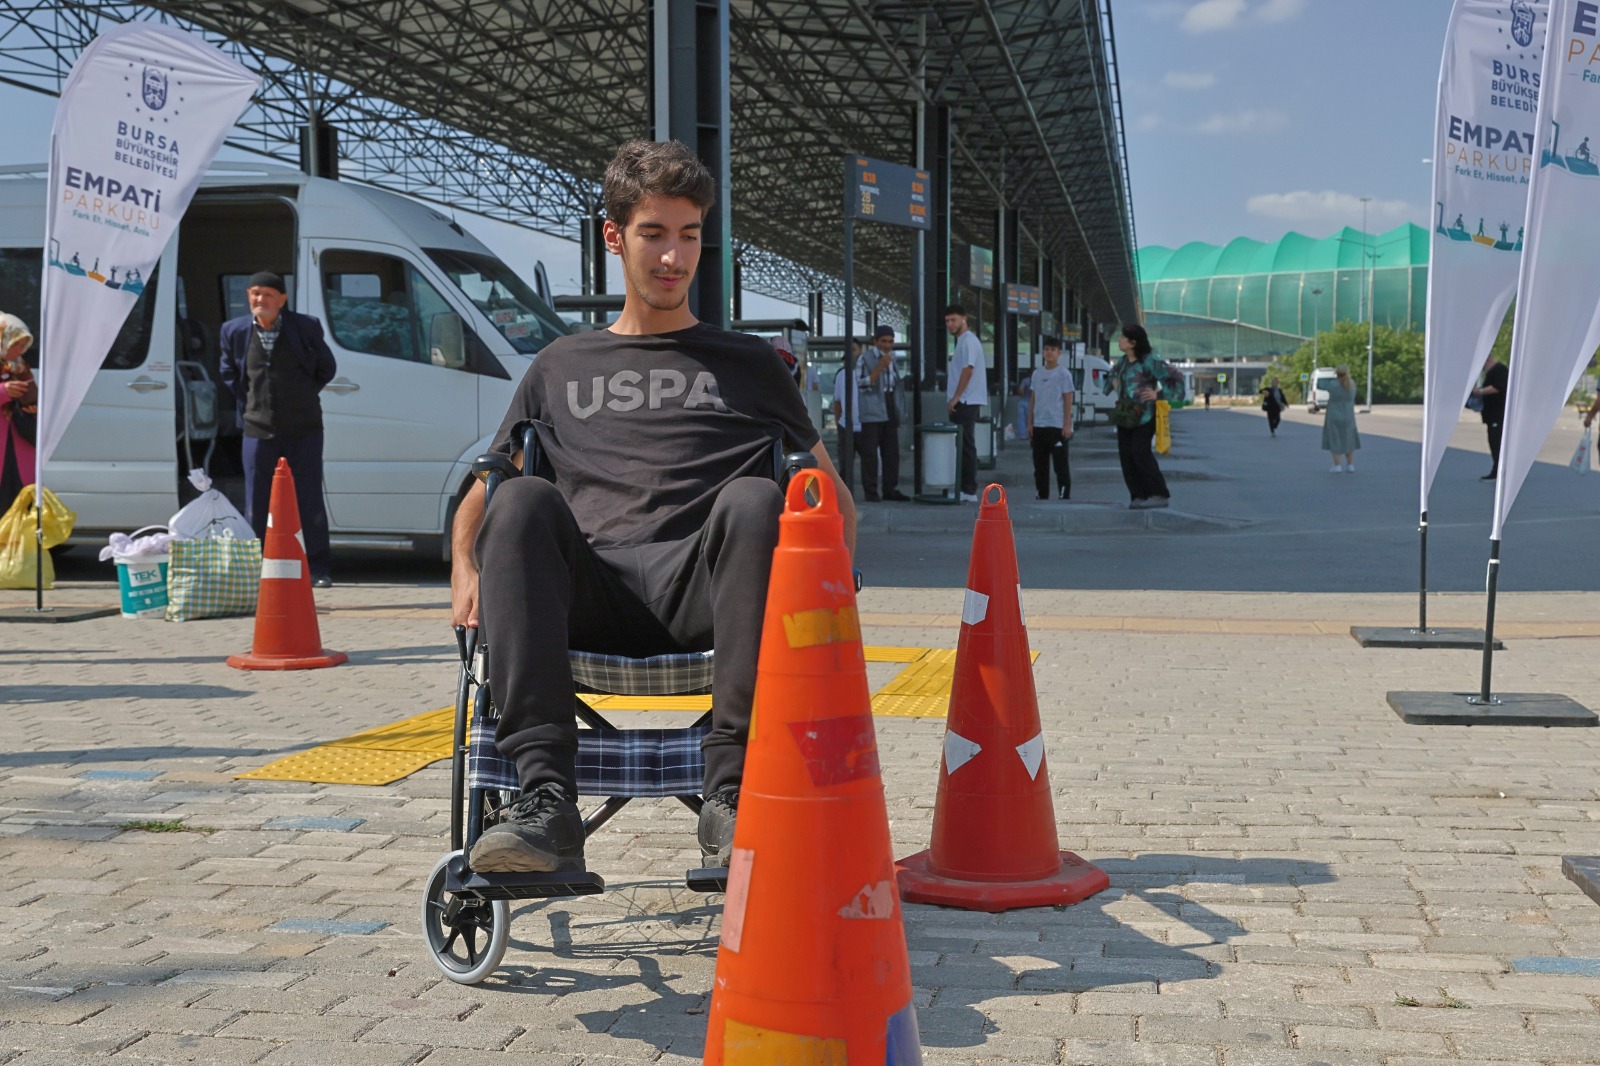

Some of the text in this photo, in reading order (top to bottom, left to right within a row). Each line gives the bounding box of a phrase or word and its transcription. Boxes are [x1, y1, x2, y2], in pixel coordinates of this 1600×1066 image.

[116, 138, 179, 168] BÜYÜKŞEHİR
[117, 121, 180, 155] BURSA
[114, 151, 177, 181] BELEDİYESİ
[1455, 165, 1472, 177] Fark
[65, 166, 161, 213] EMPATİ
[63, 189, 160, 230] PARKURU
[566, 369, 729, 420] USPA
[131, 569, 158, 581] TEK
